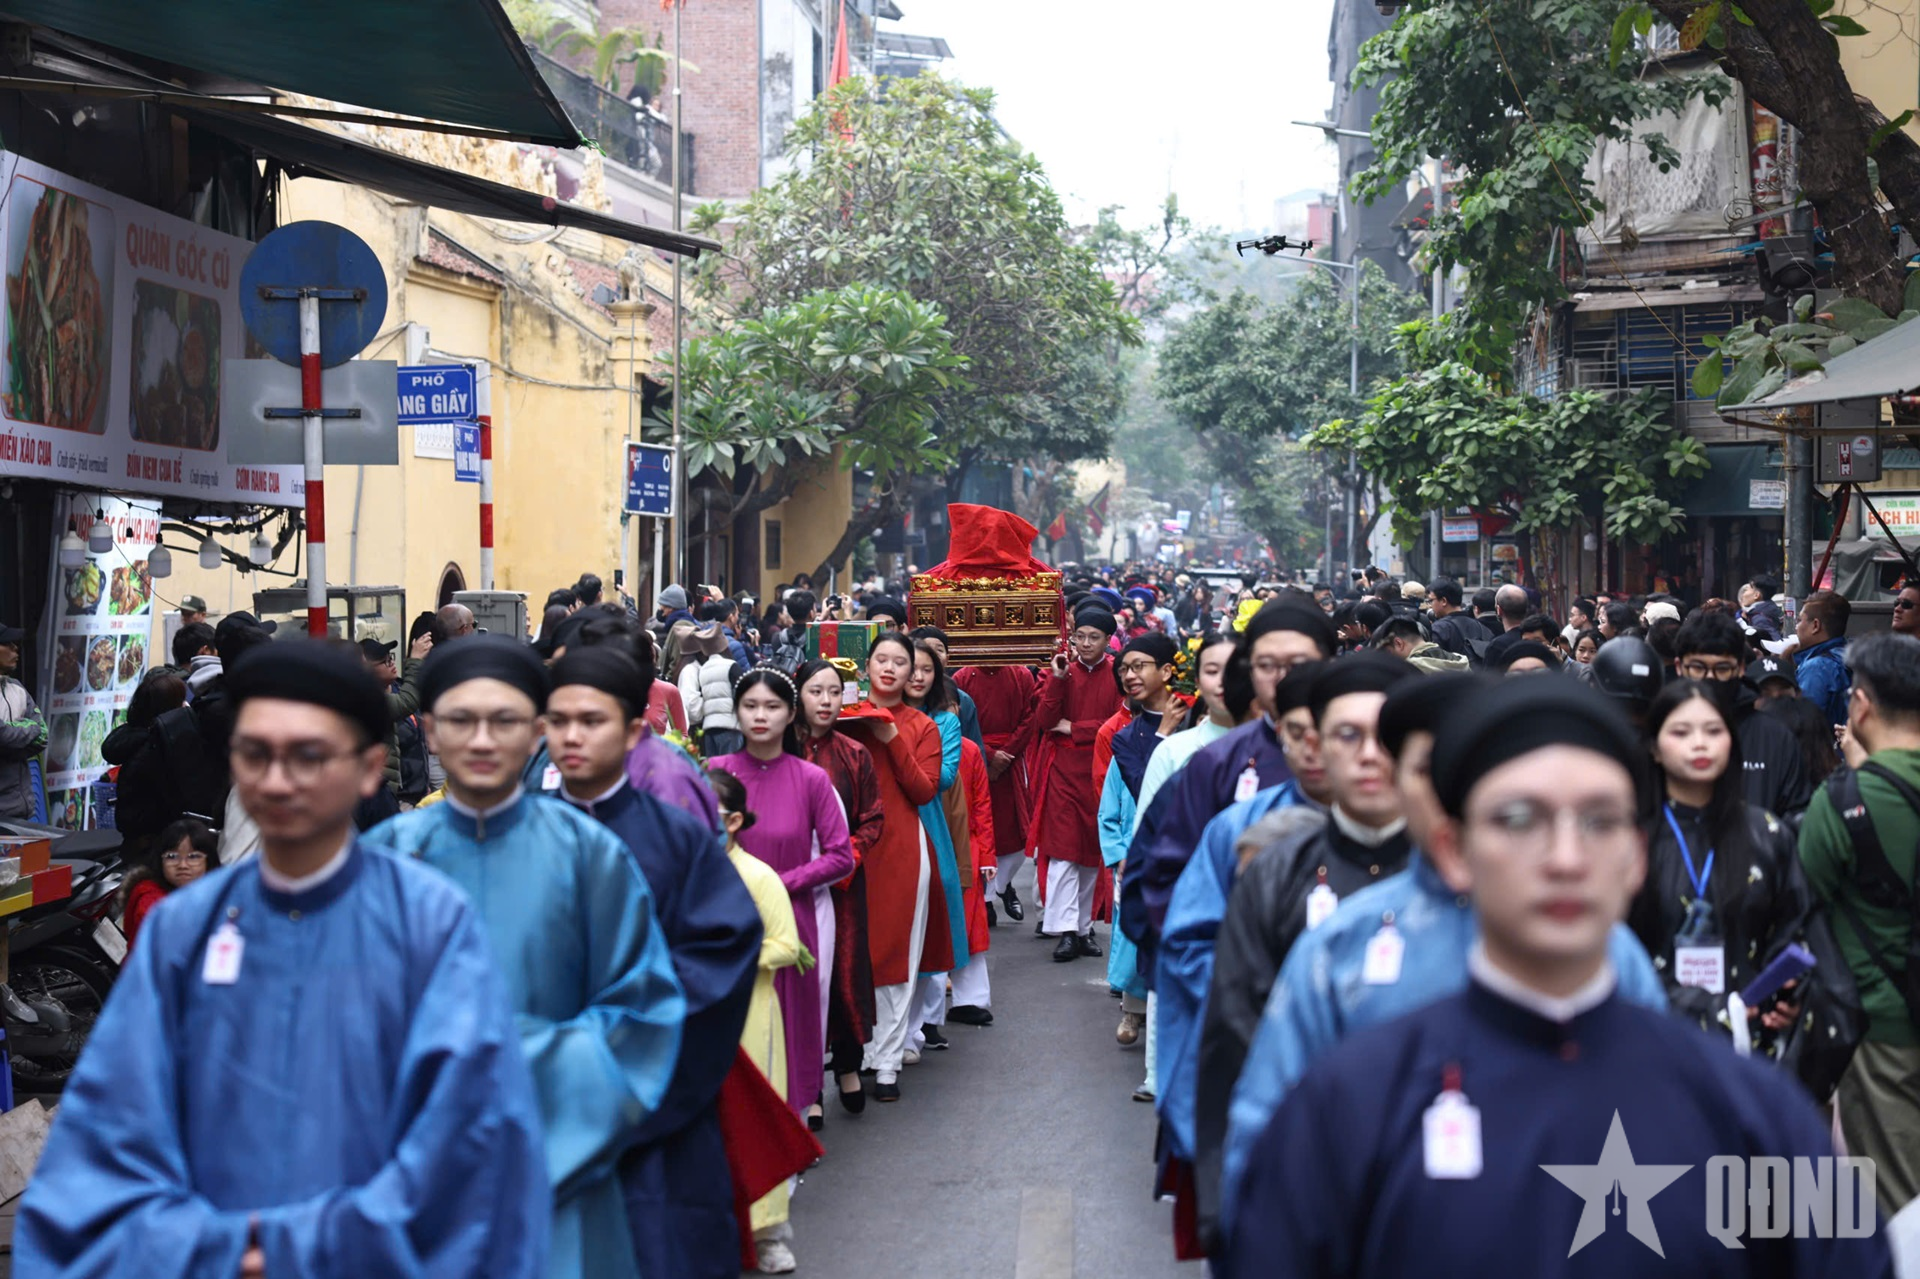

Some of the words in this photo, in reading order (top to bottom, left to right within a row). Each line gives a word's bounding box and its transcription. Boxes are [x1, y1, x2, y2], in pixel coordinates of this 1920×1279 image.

[126, 221, 170, 274] QUÁN
[411, 371, 445, 387] PHỐ
[431, 387, 468, 415] GIẦY
[37, 439, 52, 467] CUA
[142, 456, 157, 481] NEM
[159, 458, 171, 482] CUA
[250, 470, 267, 493] RANG
[268, 472, 280, 494] CUA
[1762, 658, 1778, 672] LA
